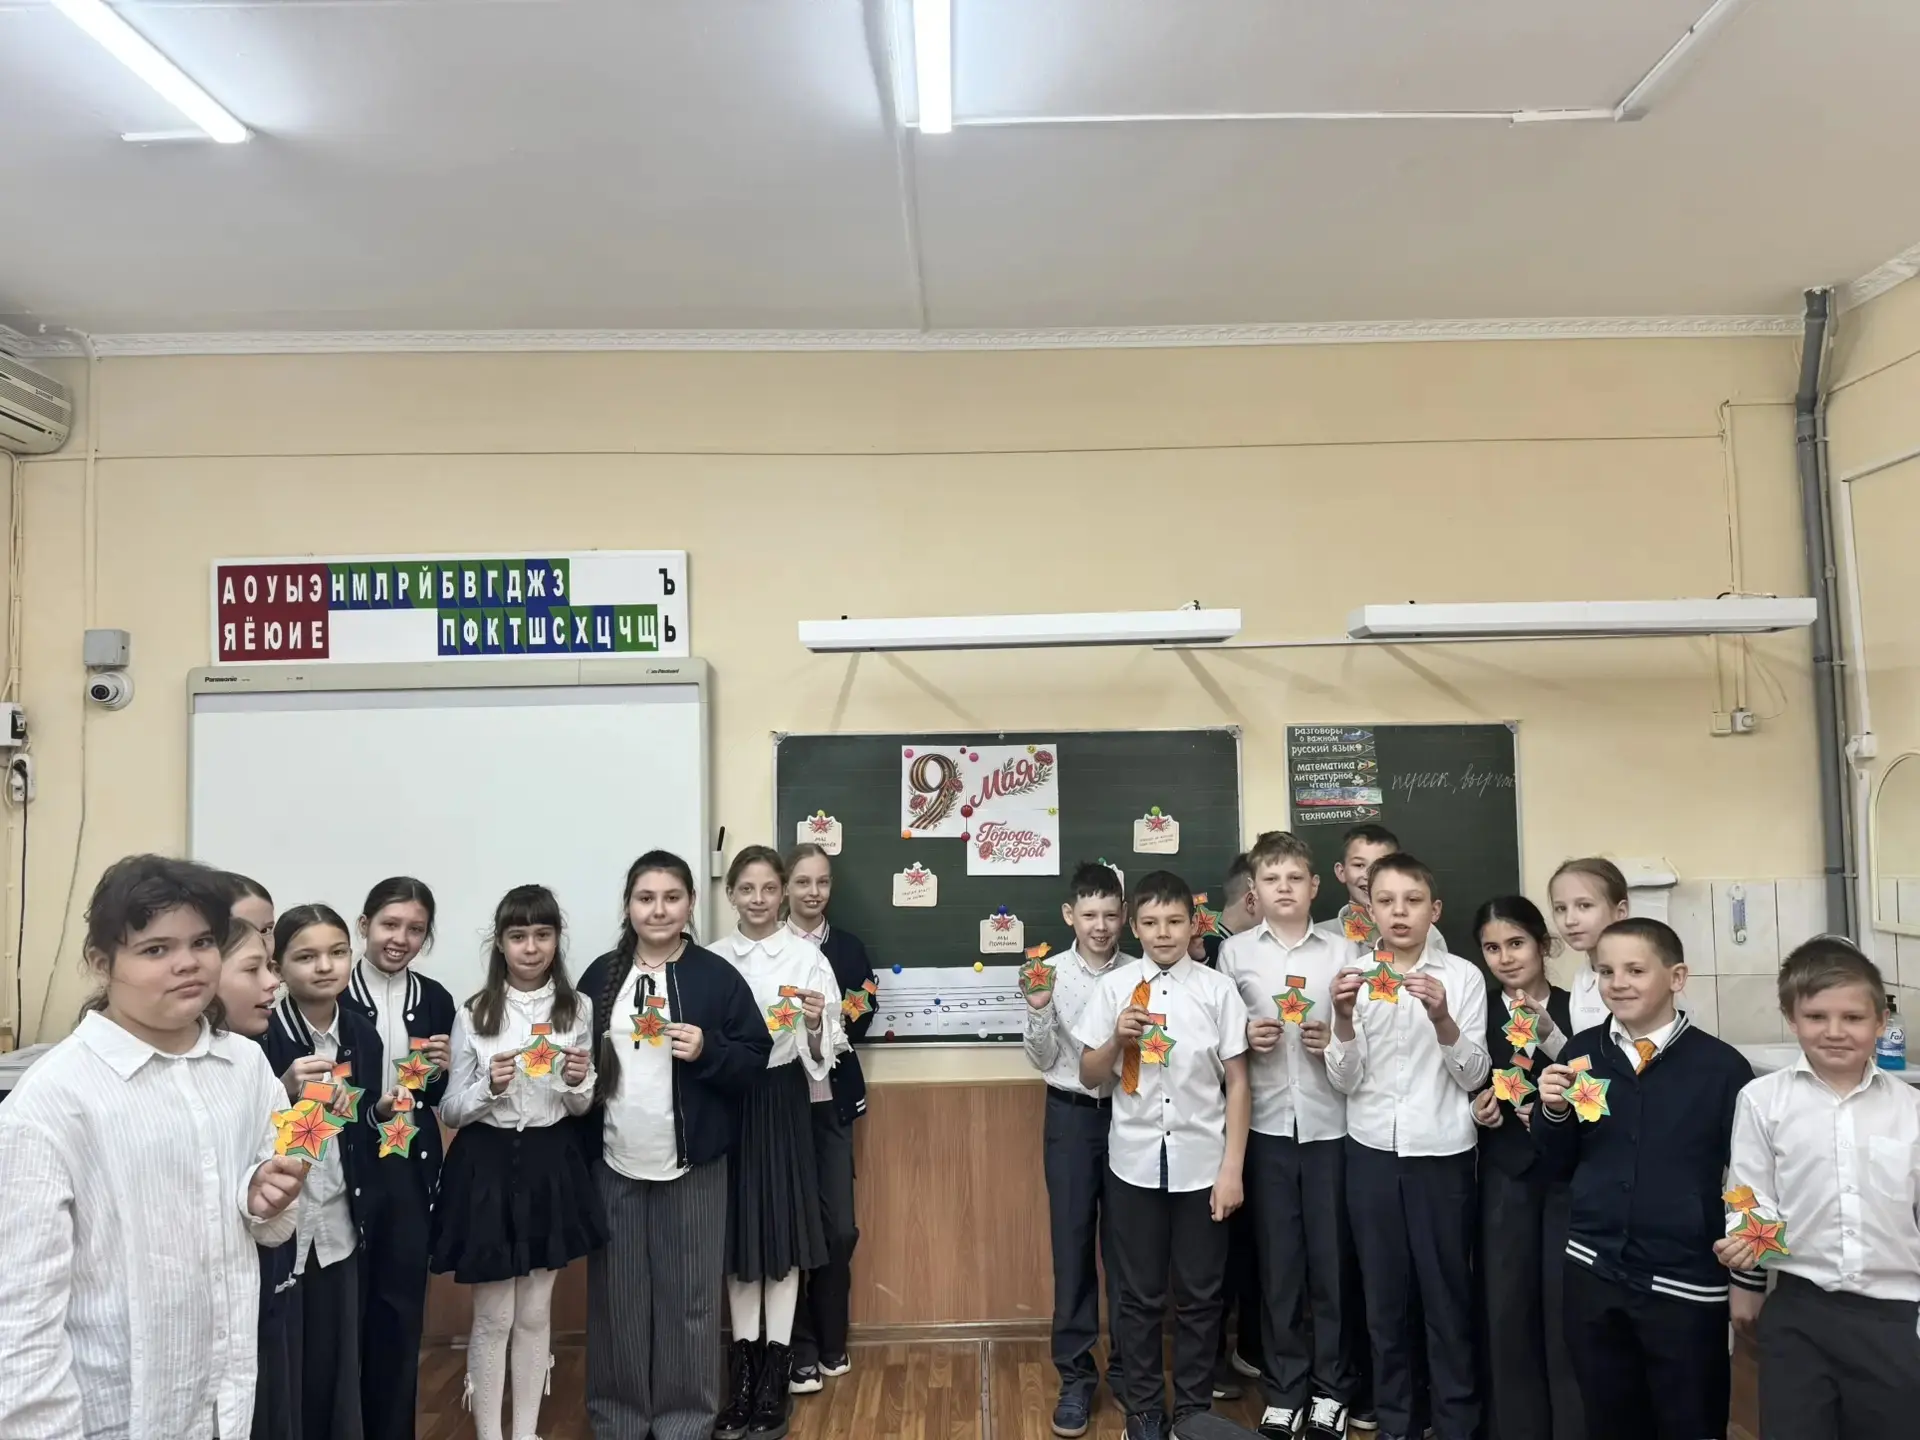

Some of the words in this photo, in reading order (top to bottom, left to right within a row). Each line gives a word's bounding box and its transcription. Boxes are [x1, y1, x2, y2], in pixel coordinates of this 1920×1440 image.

[1294, 728, 1343, 737] разговоры
[1291, 743, 1330, 756] русский
[1332, 744, 1356, 752] язык
[1297, 761, 1355, 771] математика
[1294, 772, 1354, 782] литературное
[908, 753, 958, 830] 9
[970, 759, 1040, 808] Мая
[1300, 809, 1352, 820] технология
